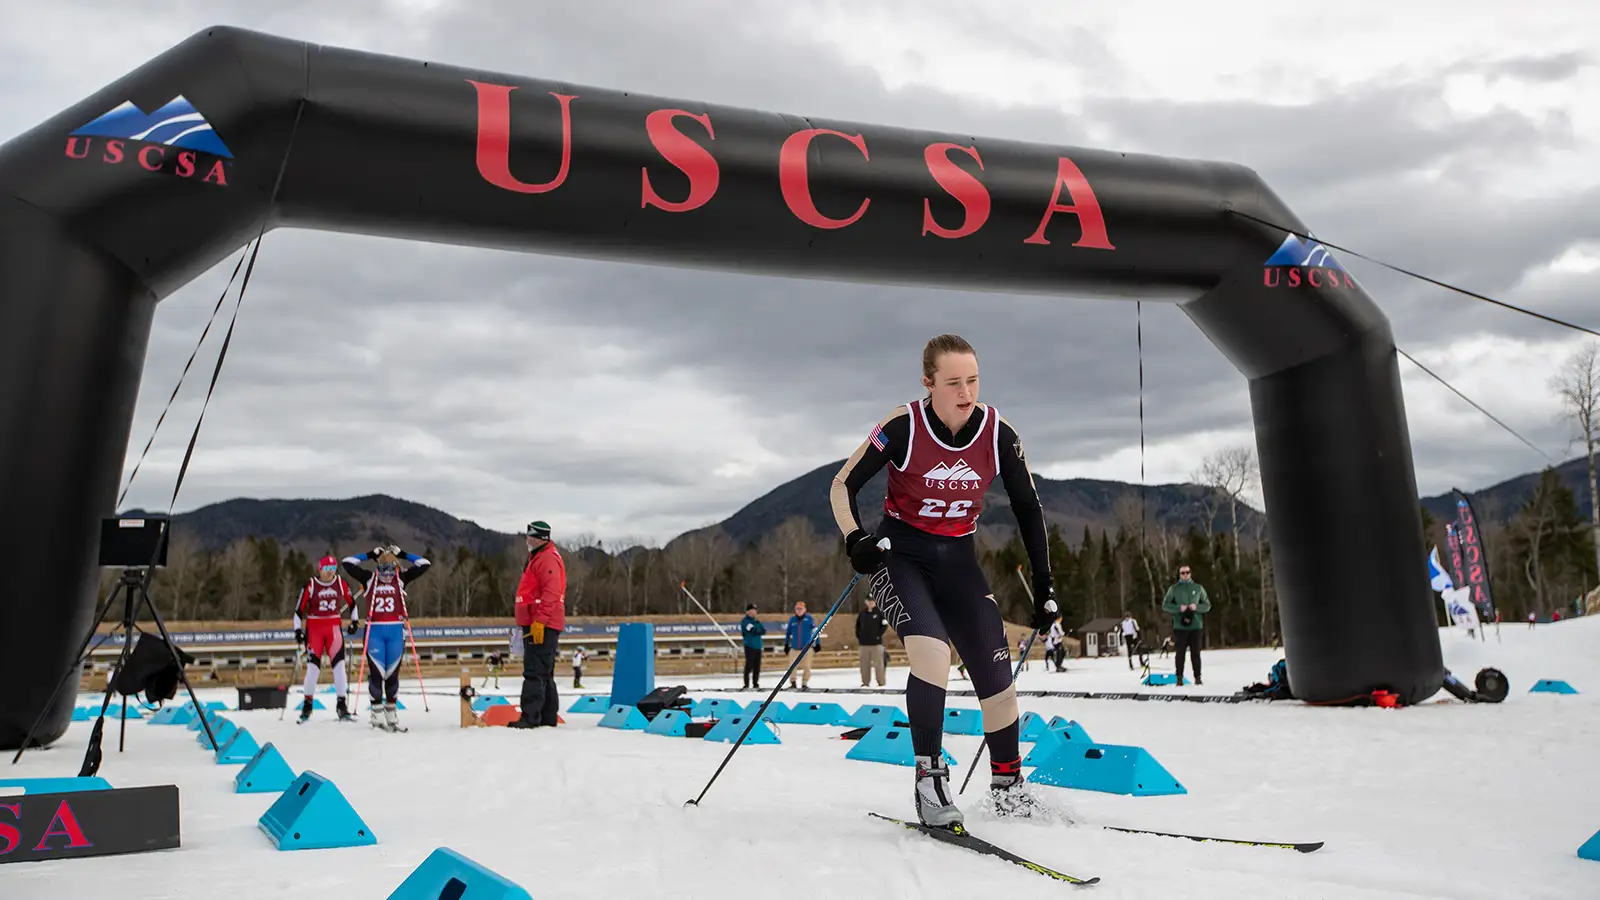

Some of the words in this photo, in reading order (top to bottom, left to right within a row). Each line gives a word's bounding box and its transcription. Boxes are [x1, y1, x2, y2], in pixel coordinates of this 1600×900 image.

[65, 137, 229, 186] USCSA
[466, 79, 1116, 250] USCSA
[1263, 267, 1356, 290] USCSA
[925, 479, 980, 491] USCSA
[318, 599, 337, 612] 24
[375, 597, 395, 613] 23
[868, 566, 912, 631] RMY
[673, 624, 697, 632] WORLD
